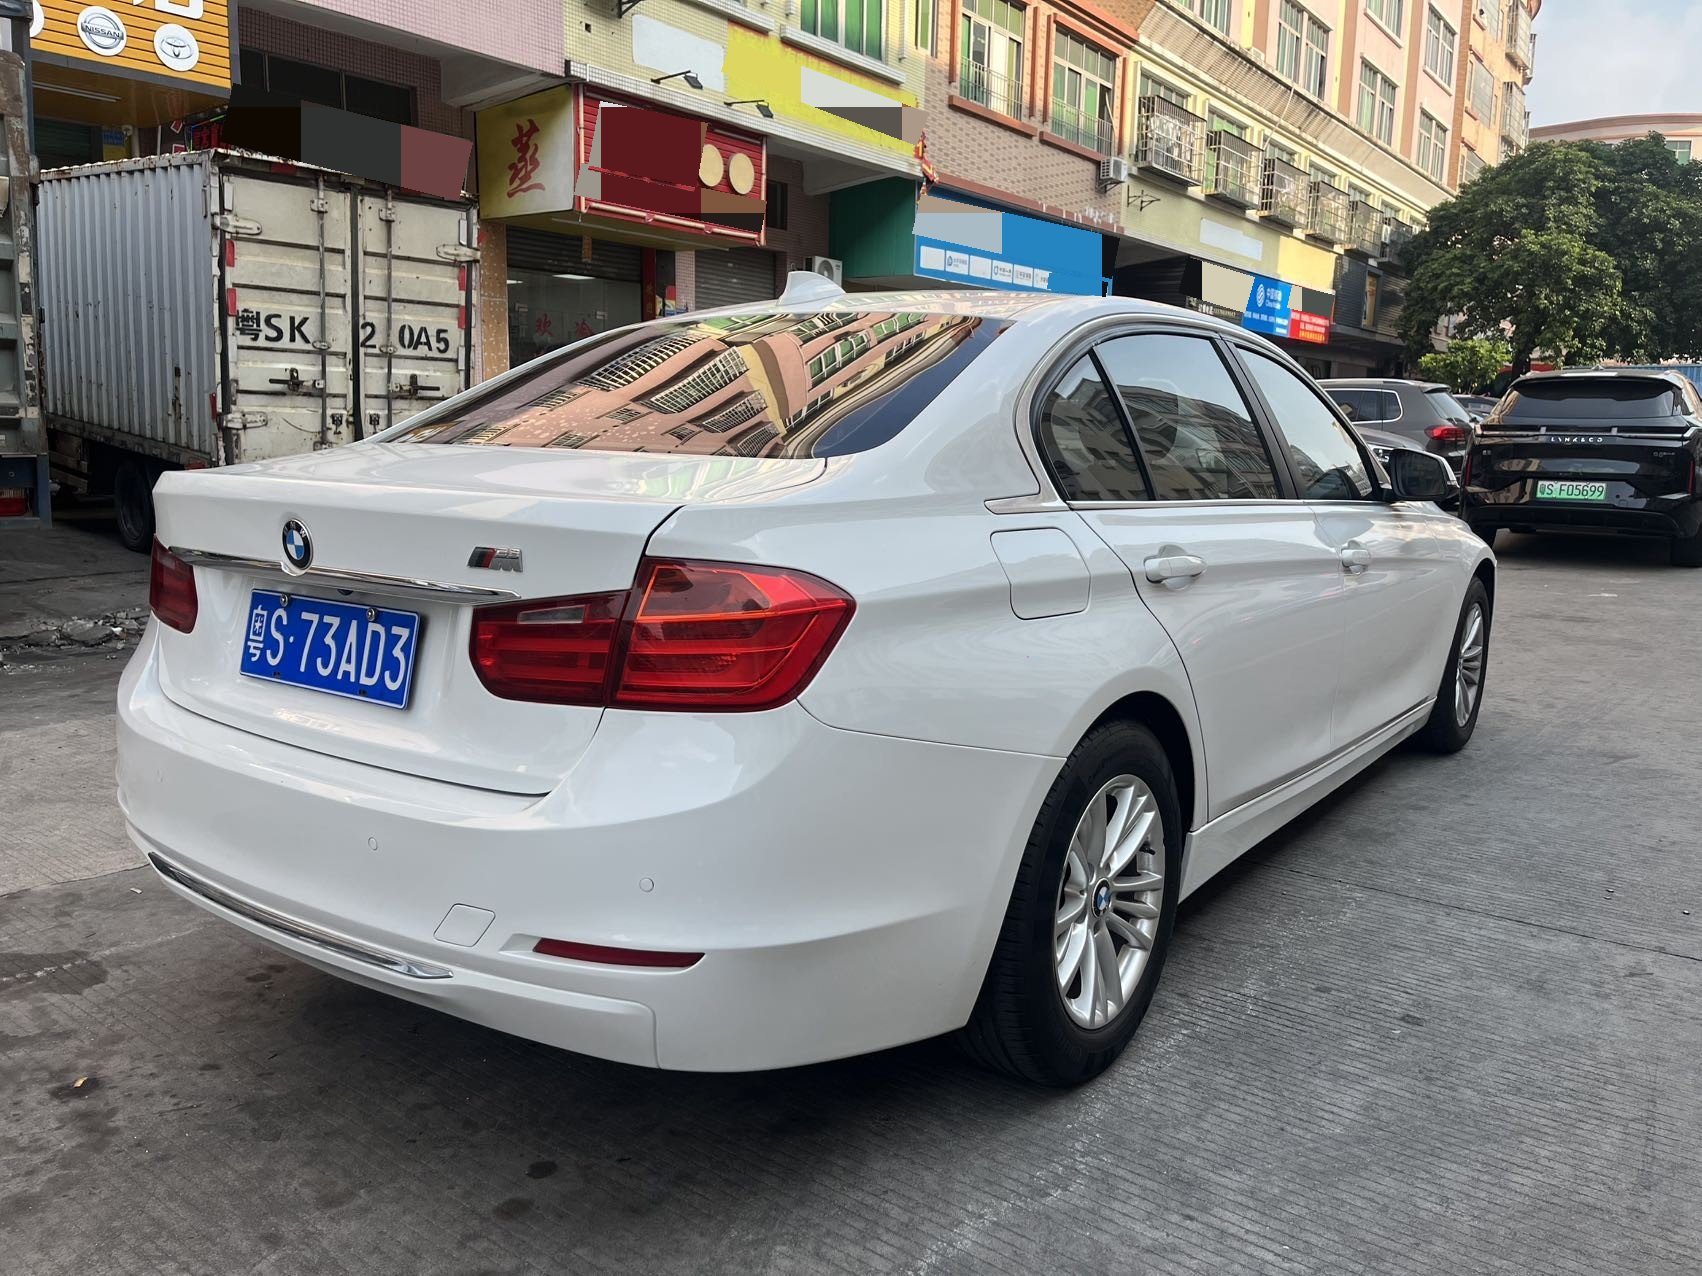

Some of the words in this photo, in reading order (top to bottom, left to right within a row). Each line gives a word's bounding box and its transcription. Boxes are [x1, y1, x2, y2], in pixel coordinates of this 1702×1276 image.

[85, 25, 121, 38] NISSAN
[507, 119, 545, 198] 蒸
[247, 604, 411, 691] 粤S·73AD3
